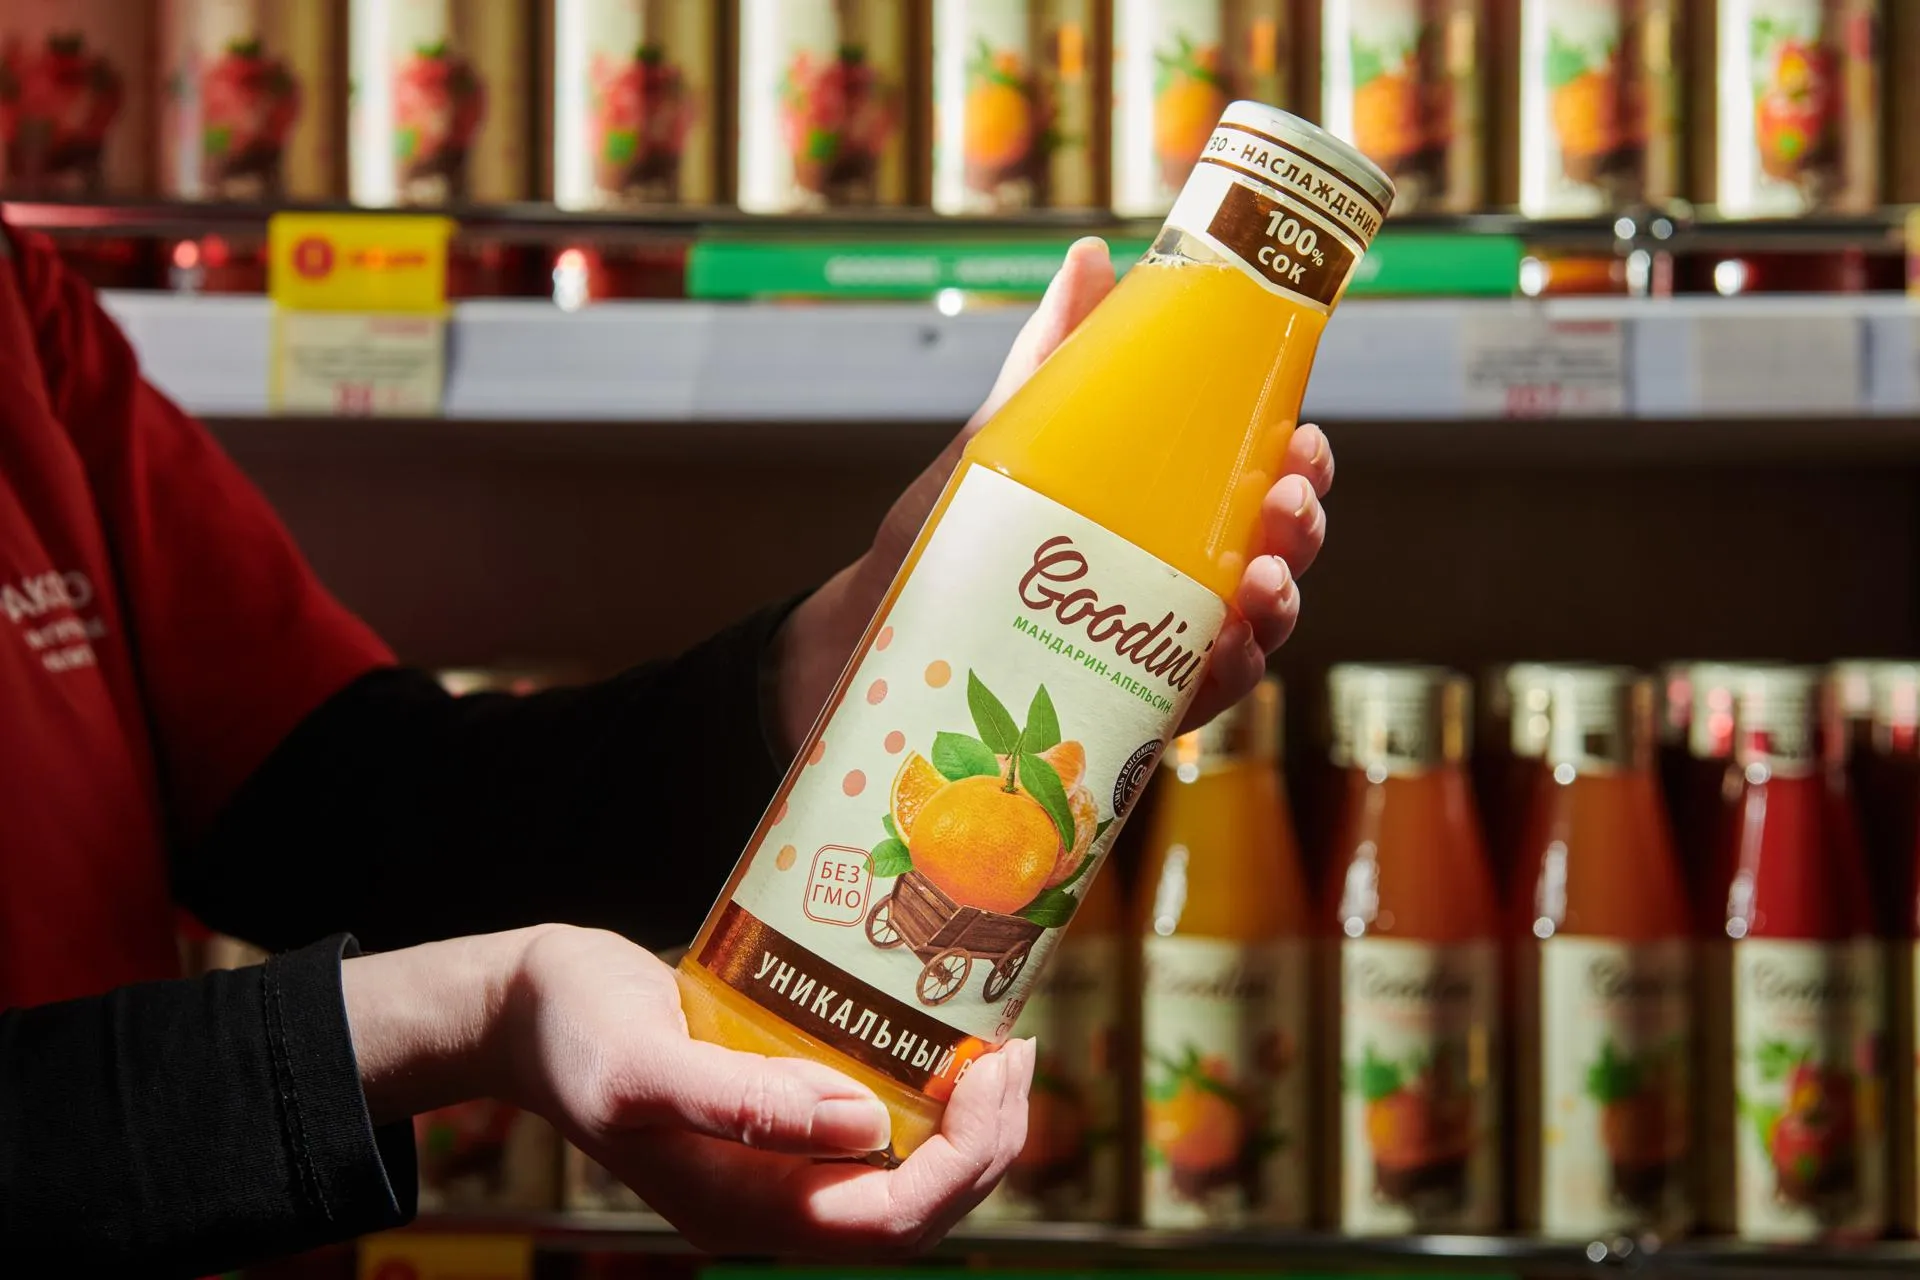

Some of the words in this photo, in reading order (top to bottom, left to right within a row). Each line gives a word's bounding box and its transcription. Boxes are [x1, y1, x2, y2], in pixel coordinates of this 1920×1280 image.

[1240, 143, 1377, 238] НАСЛАЖДЕНИЕ
[1257, 245, 1308, 285] СОК
[1262, 210, 1325, 268] 100%
[1018, 535, 1214, 694] Goodini
[1012, 615, 1173, 715] МАНДАРИН-АПЕЛЬСИН
[811, 884, 861, 909] ГМО
[820, 861, 861, 884] БЕЗ
[753, 951, 957, 1079] УНИКАЛЬНЫЙ
